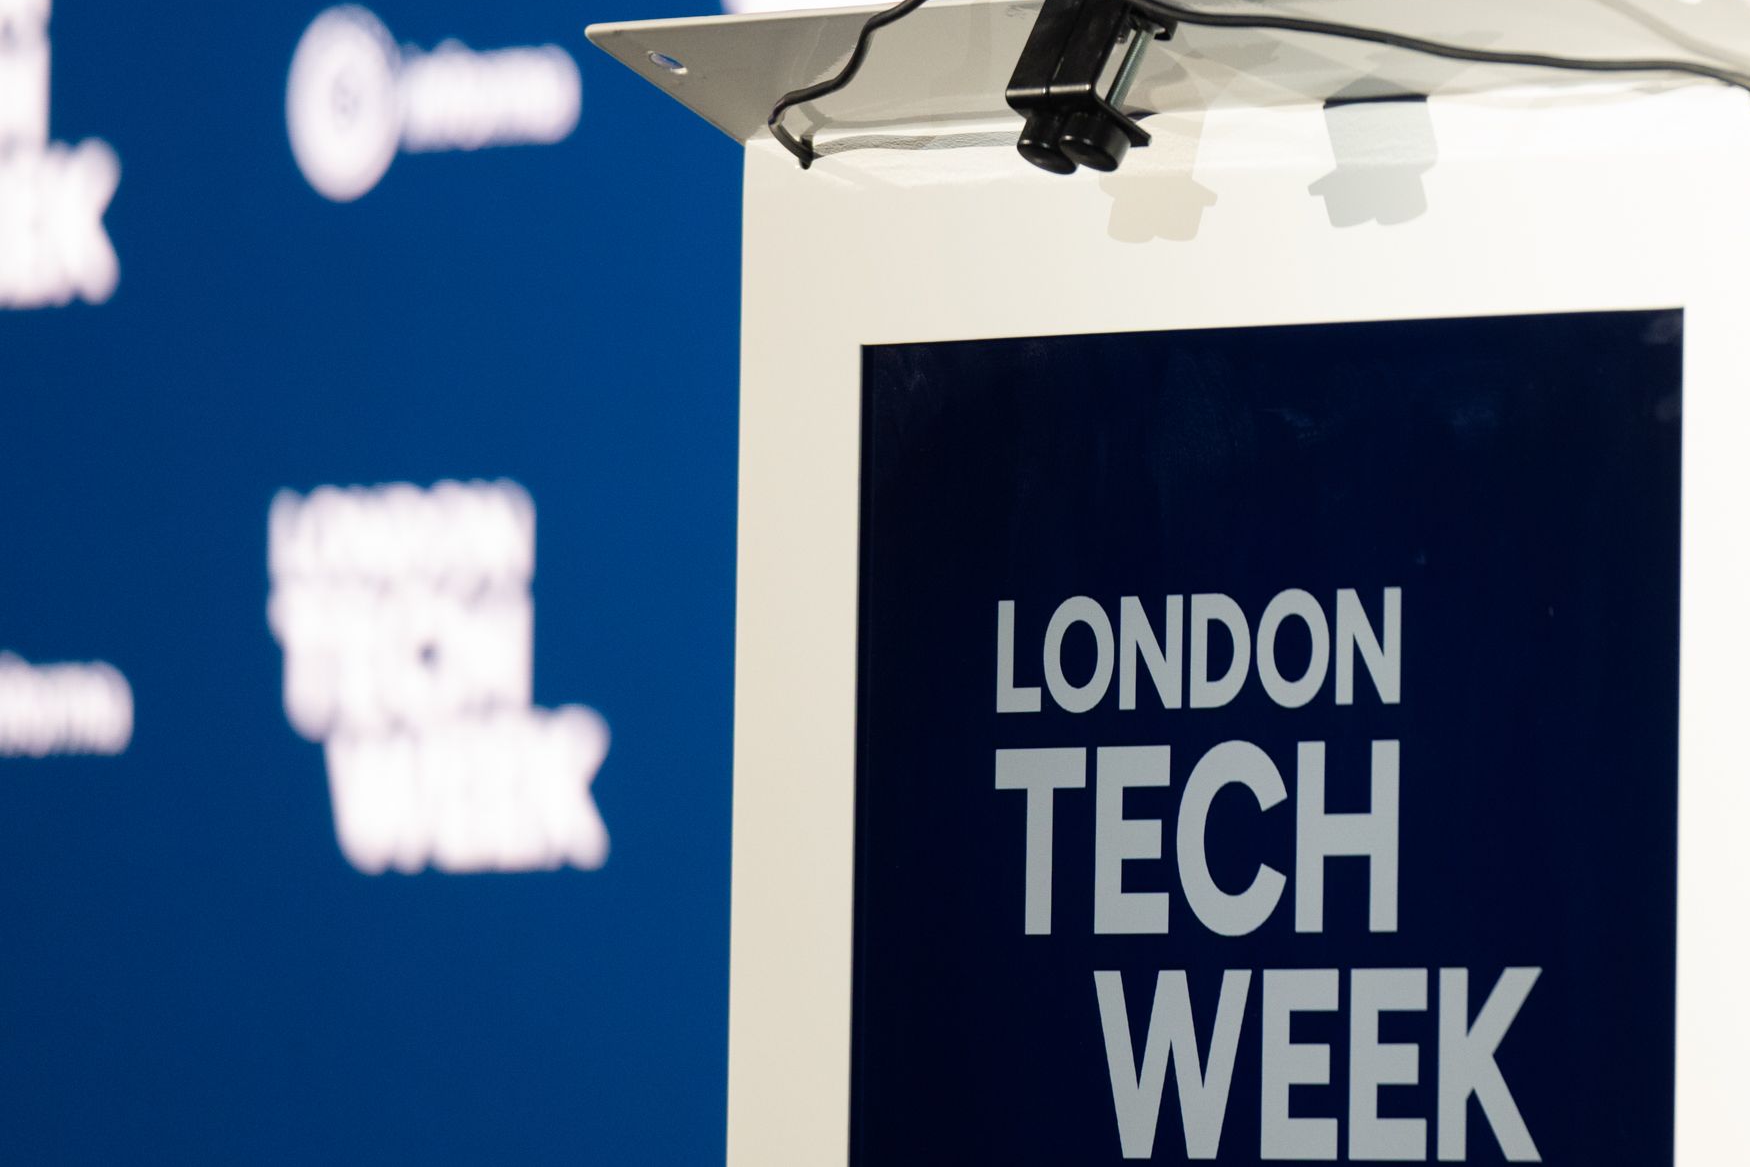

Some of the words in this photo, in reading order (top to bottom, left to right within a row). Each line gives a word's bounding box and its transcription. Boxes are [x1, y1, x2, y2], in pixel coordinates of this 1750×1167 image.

[996, 586, 1402, 714] LONDON
[994, 739, 1400, 937] TECH
[1093, 966, 1542, 1163] WEEK
